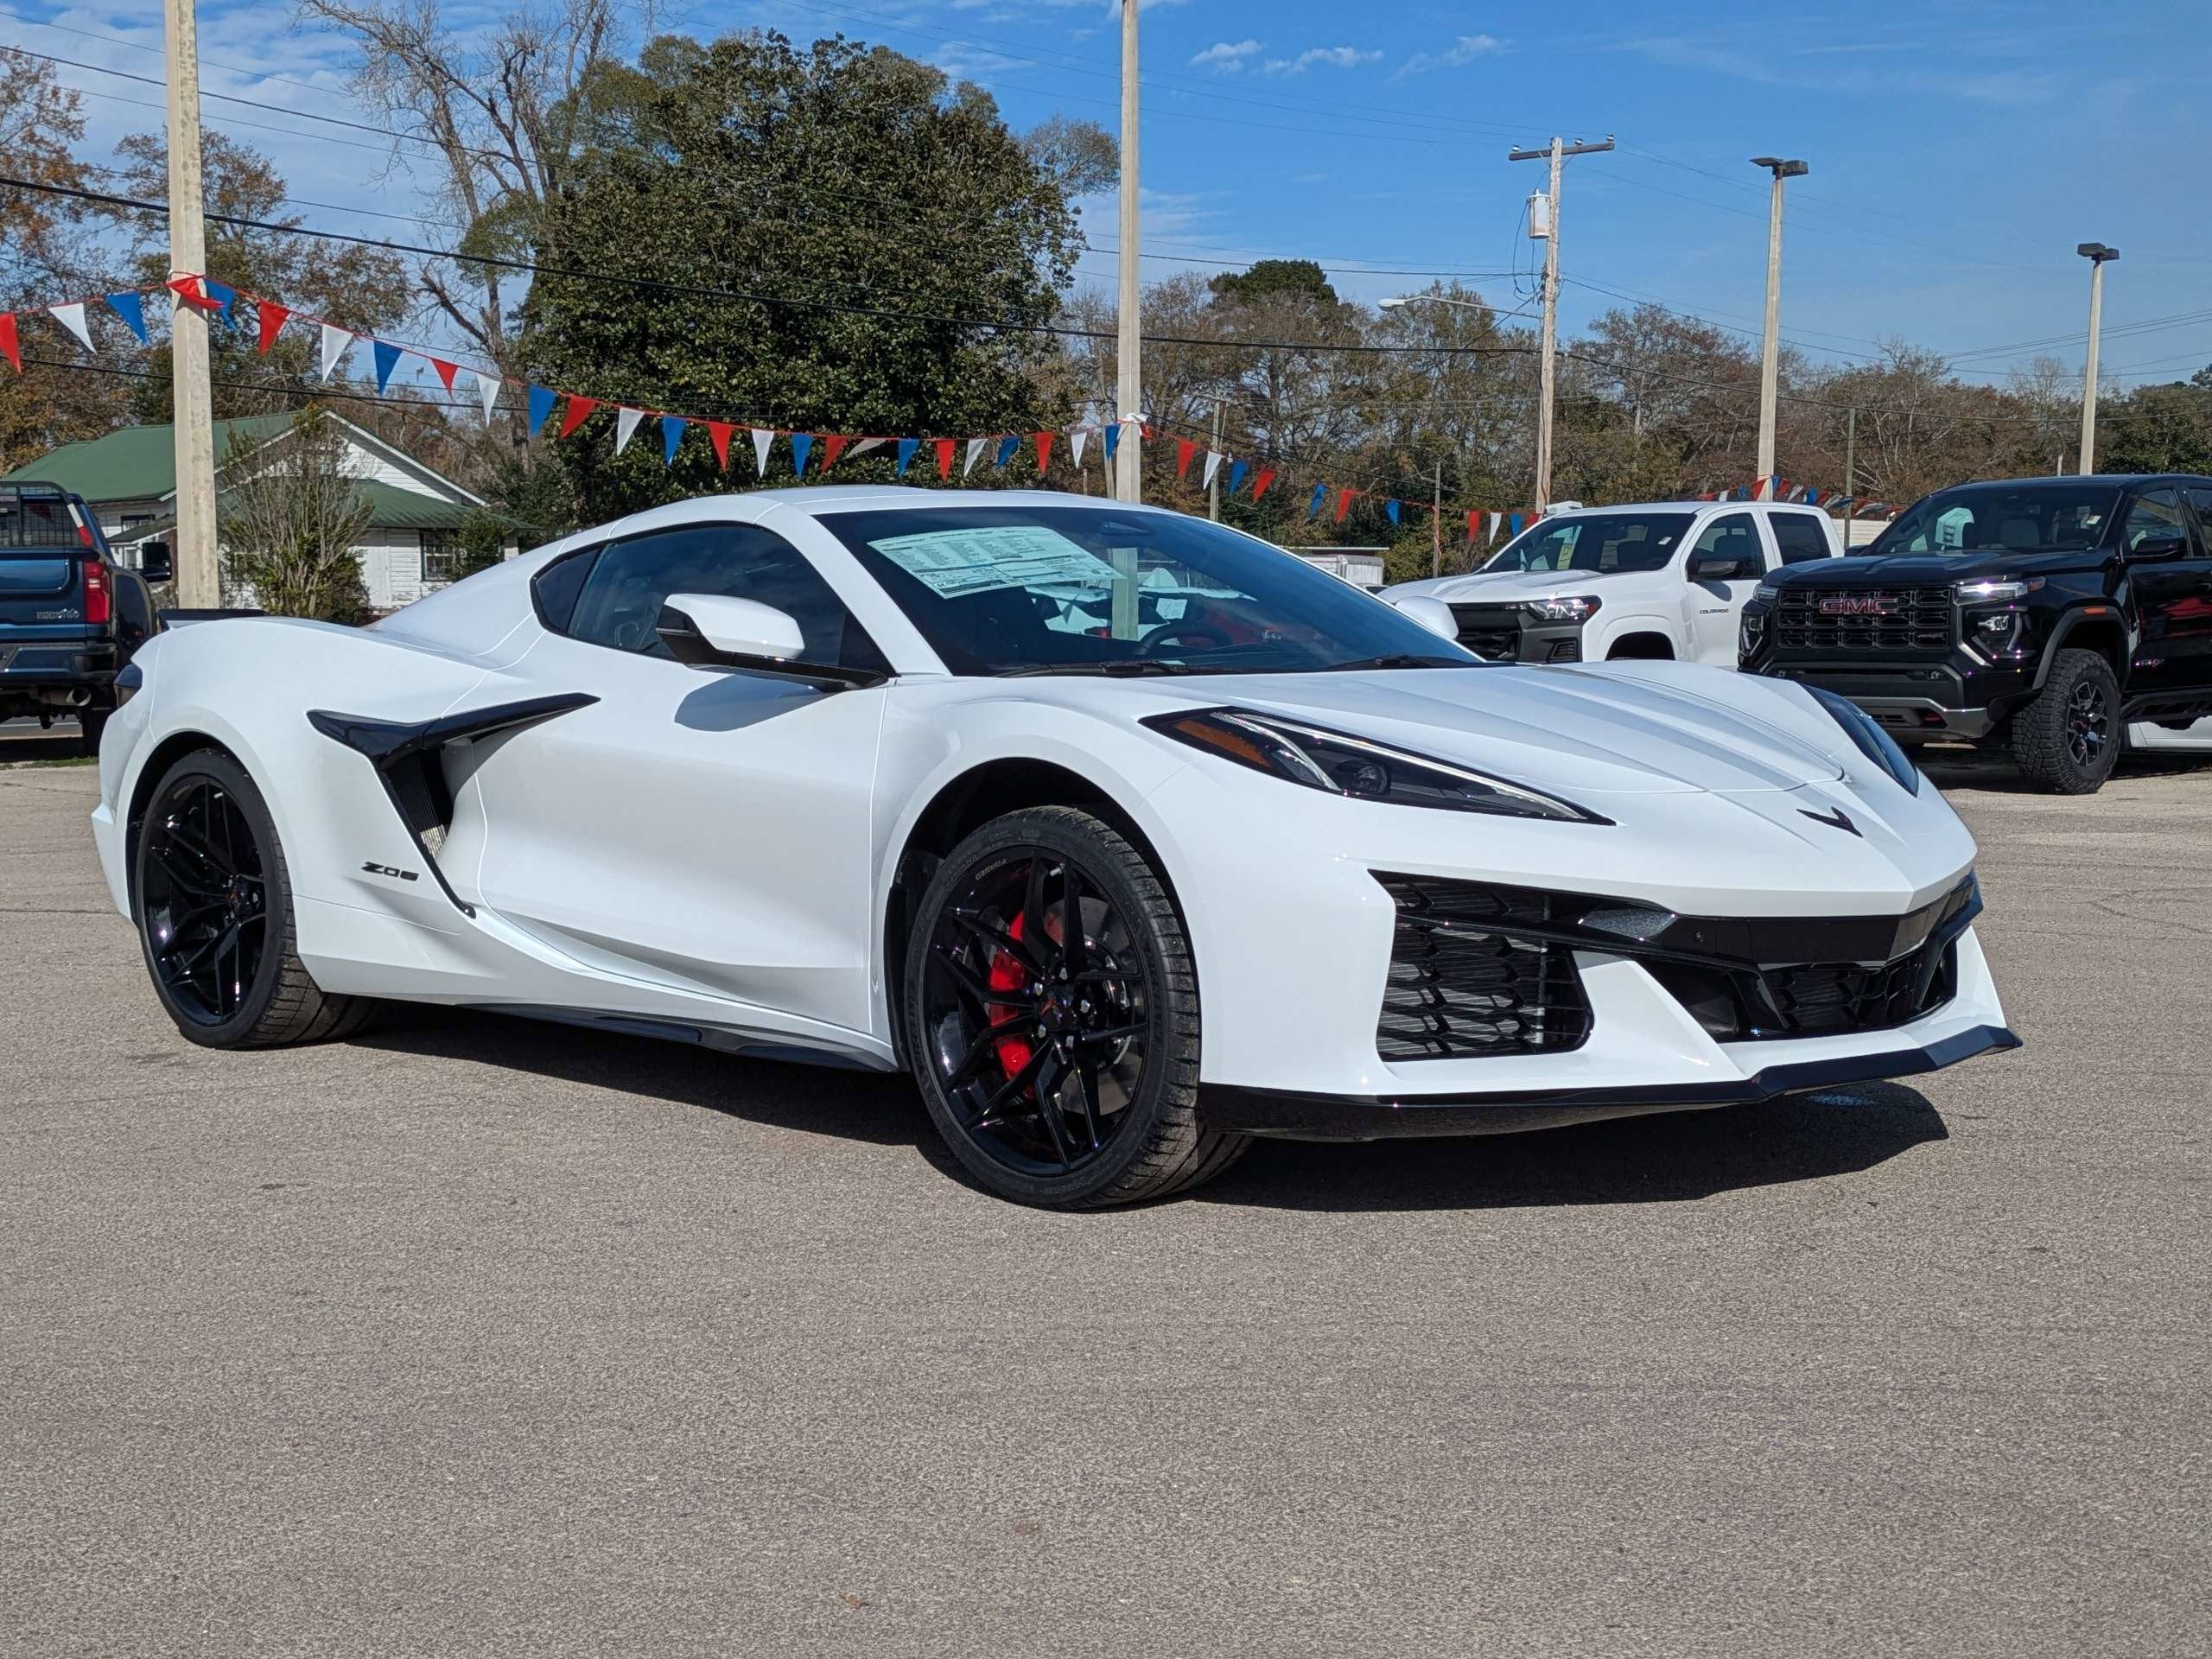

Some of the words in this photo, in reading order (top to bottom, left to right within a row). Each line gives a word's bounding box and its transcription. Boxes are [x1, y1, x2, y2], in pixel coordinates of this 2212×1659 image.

[1819, 598, 1897, 614] GMC
[361, 861, 419, 881] Z06
[975, 858, 1007, 880] FORGED
